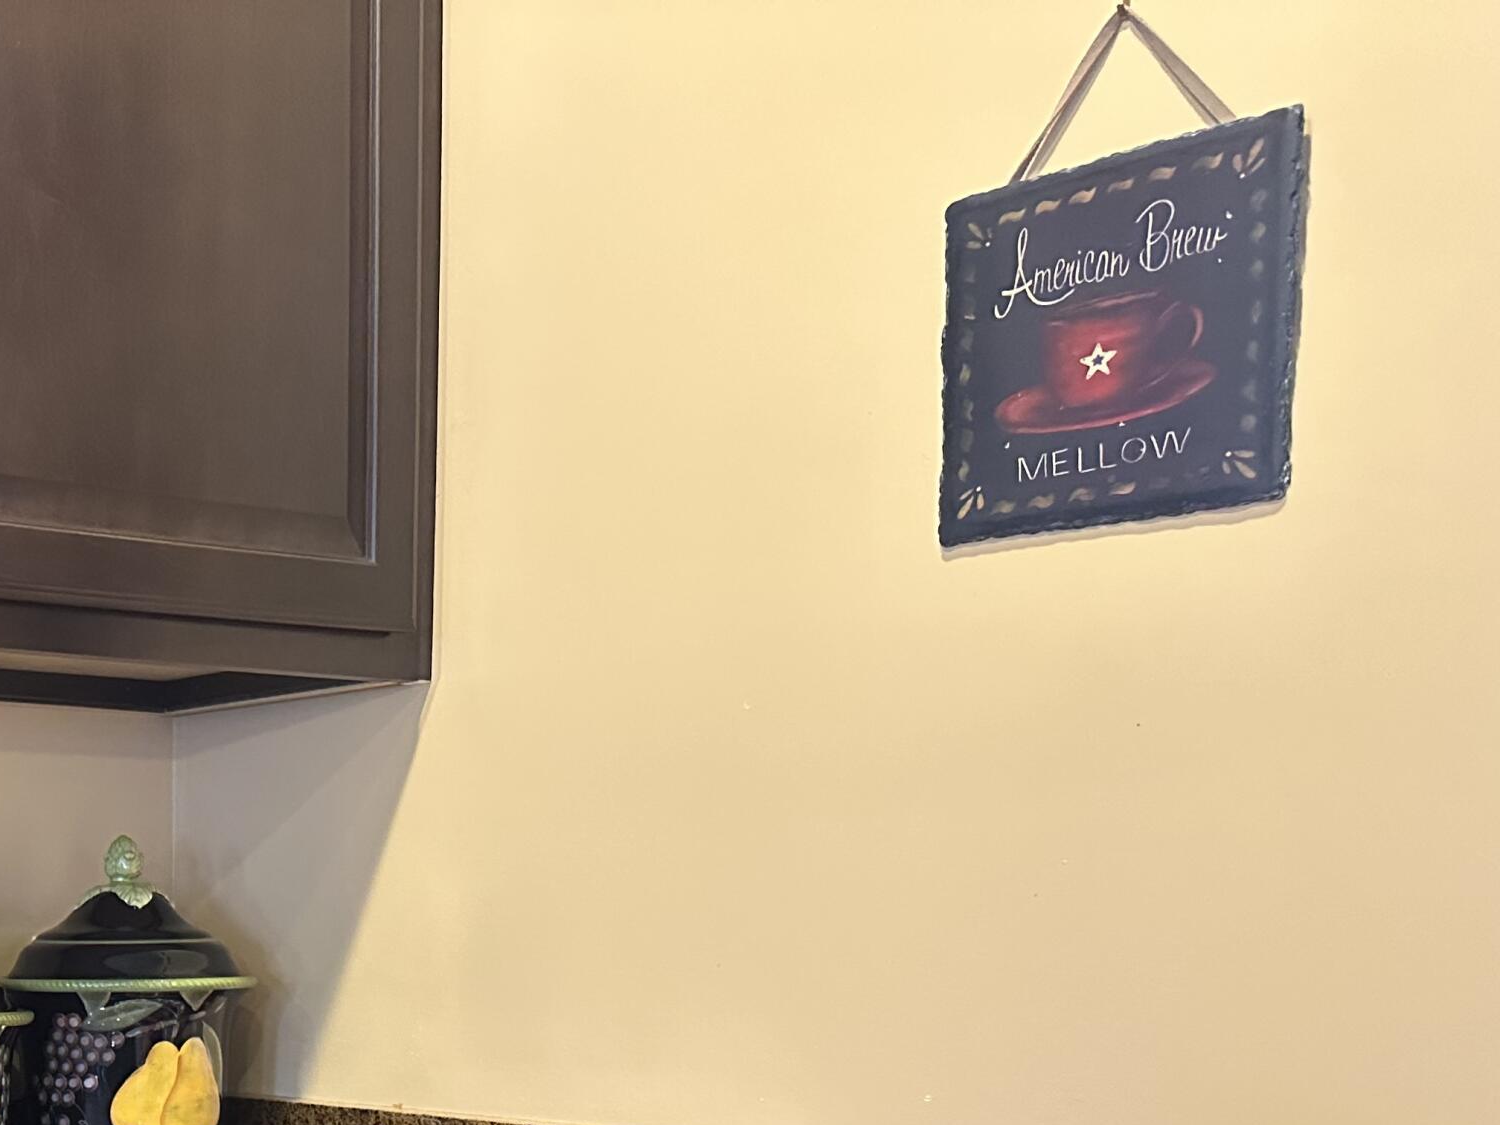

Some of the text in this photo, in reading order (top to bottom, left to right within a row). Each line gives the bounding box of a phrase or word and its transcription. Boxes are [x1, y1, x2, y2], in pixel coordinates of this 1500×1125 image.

[994, 199, 1227, 318] American Brew
[1017, 426, 1192, 482] MELLOW
